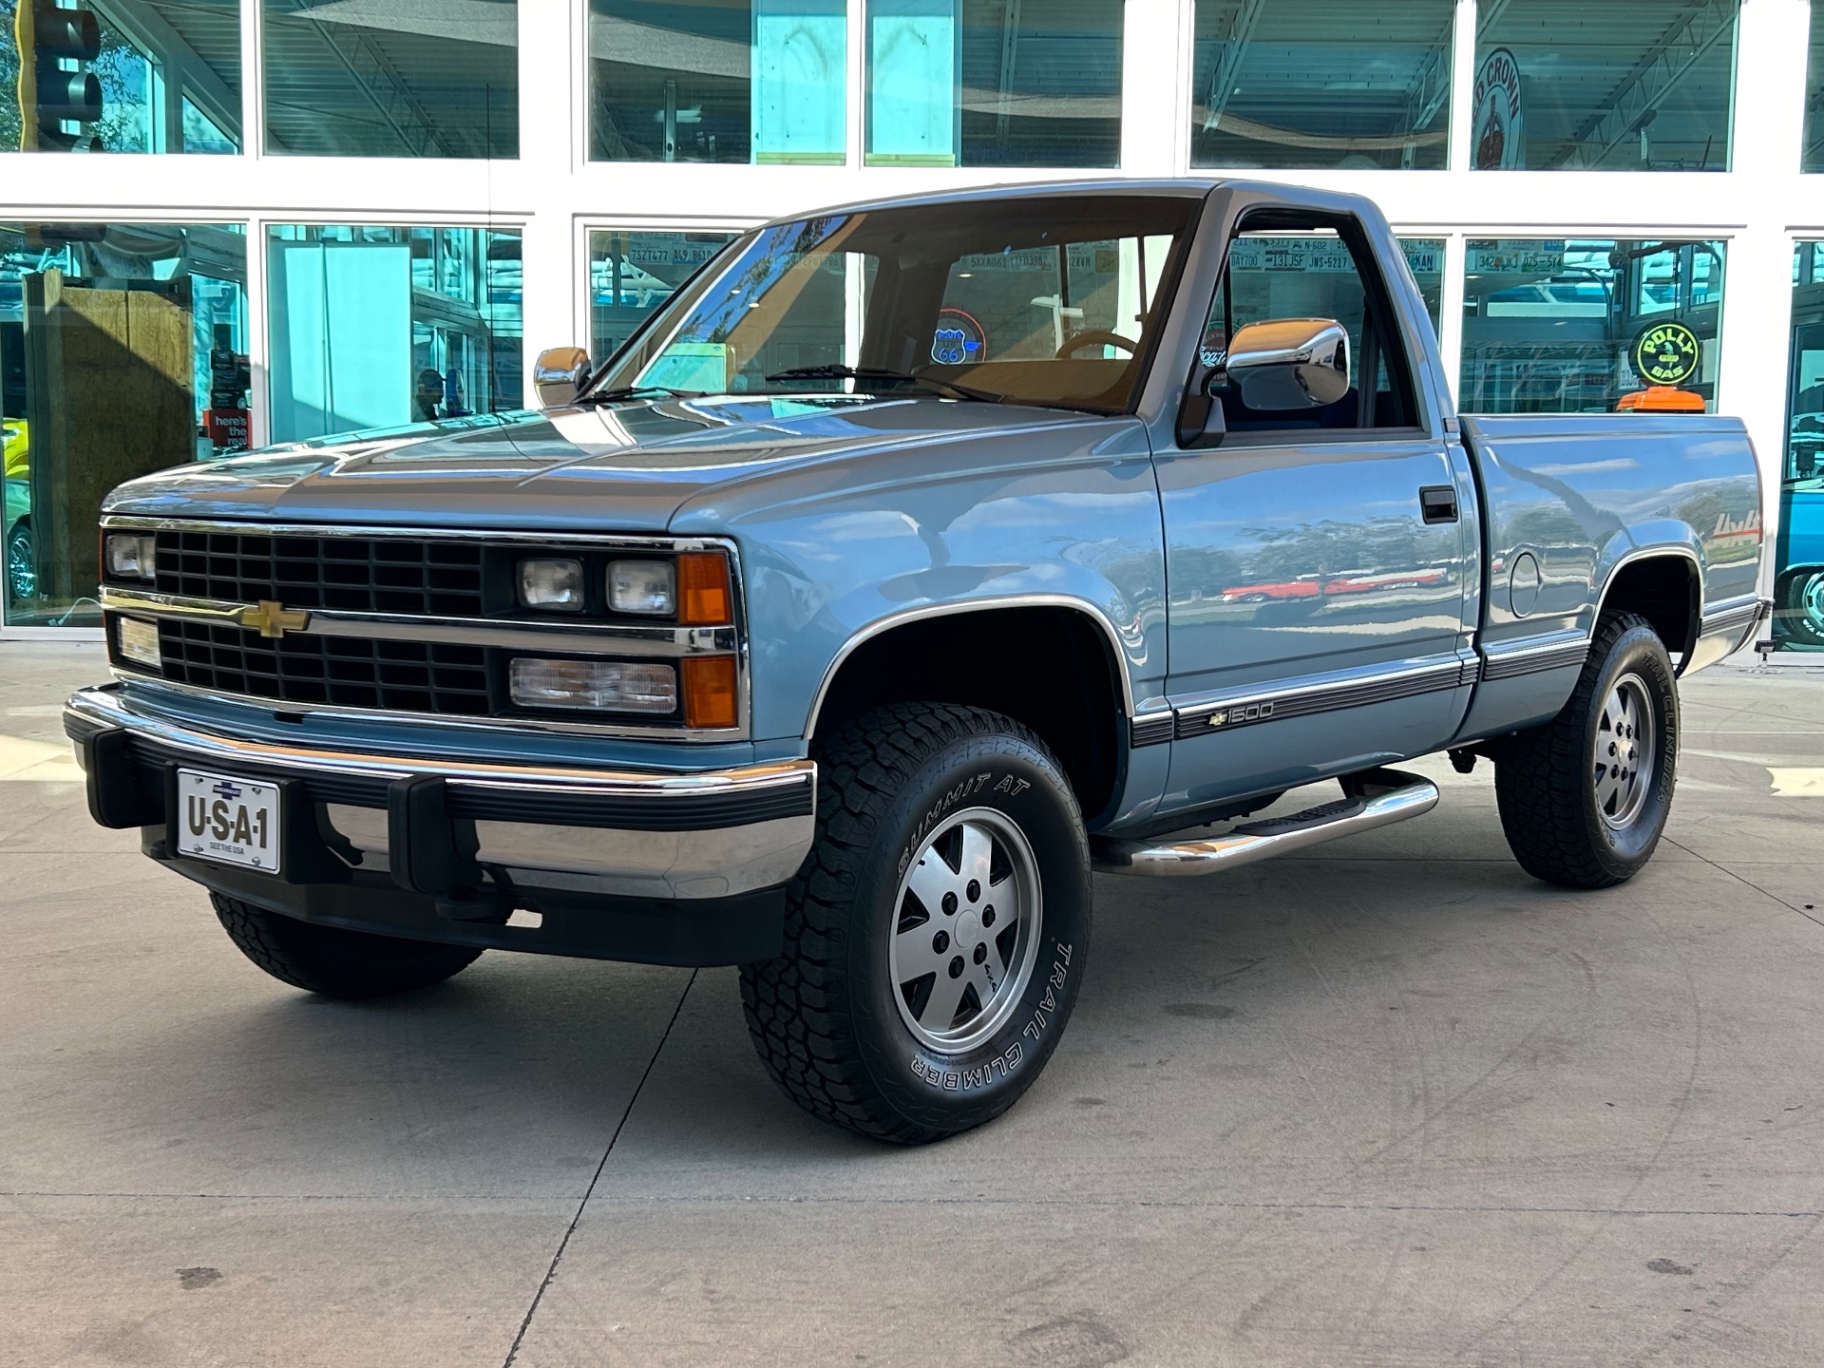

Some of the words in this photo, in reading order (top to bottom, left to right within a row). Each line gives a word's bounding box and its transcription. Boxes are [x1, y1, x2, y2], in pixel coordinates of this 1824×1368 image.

[1487, 57, 1519, 120] CROWN
[937, 331, 963, 340] ROUTE
[1643, 328, 1694, 354] POLLY
[938, 347, 958, 361] 66
[1650, 365, 1684, 379] GAS
[215, 416, 248, 427] here's
[229, 426, 248, 437] the
[227, 437, 248, 447] real
[1227, 702, 1274, 724] 1500
[897, 771, 992, 879] SUMMIT
[993, 773, 1031, 797] AT
[1023, 942, 1073, 1041] TRAIL
[910, 1041, 1024, 1091] CLIMBER
